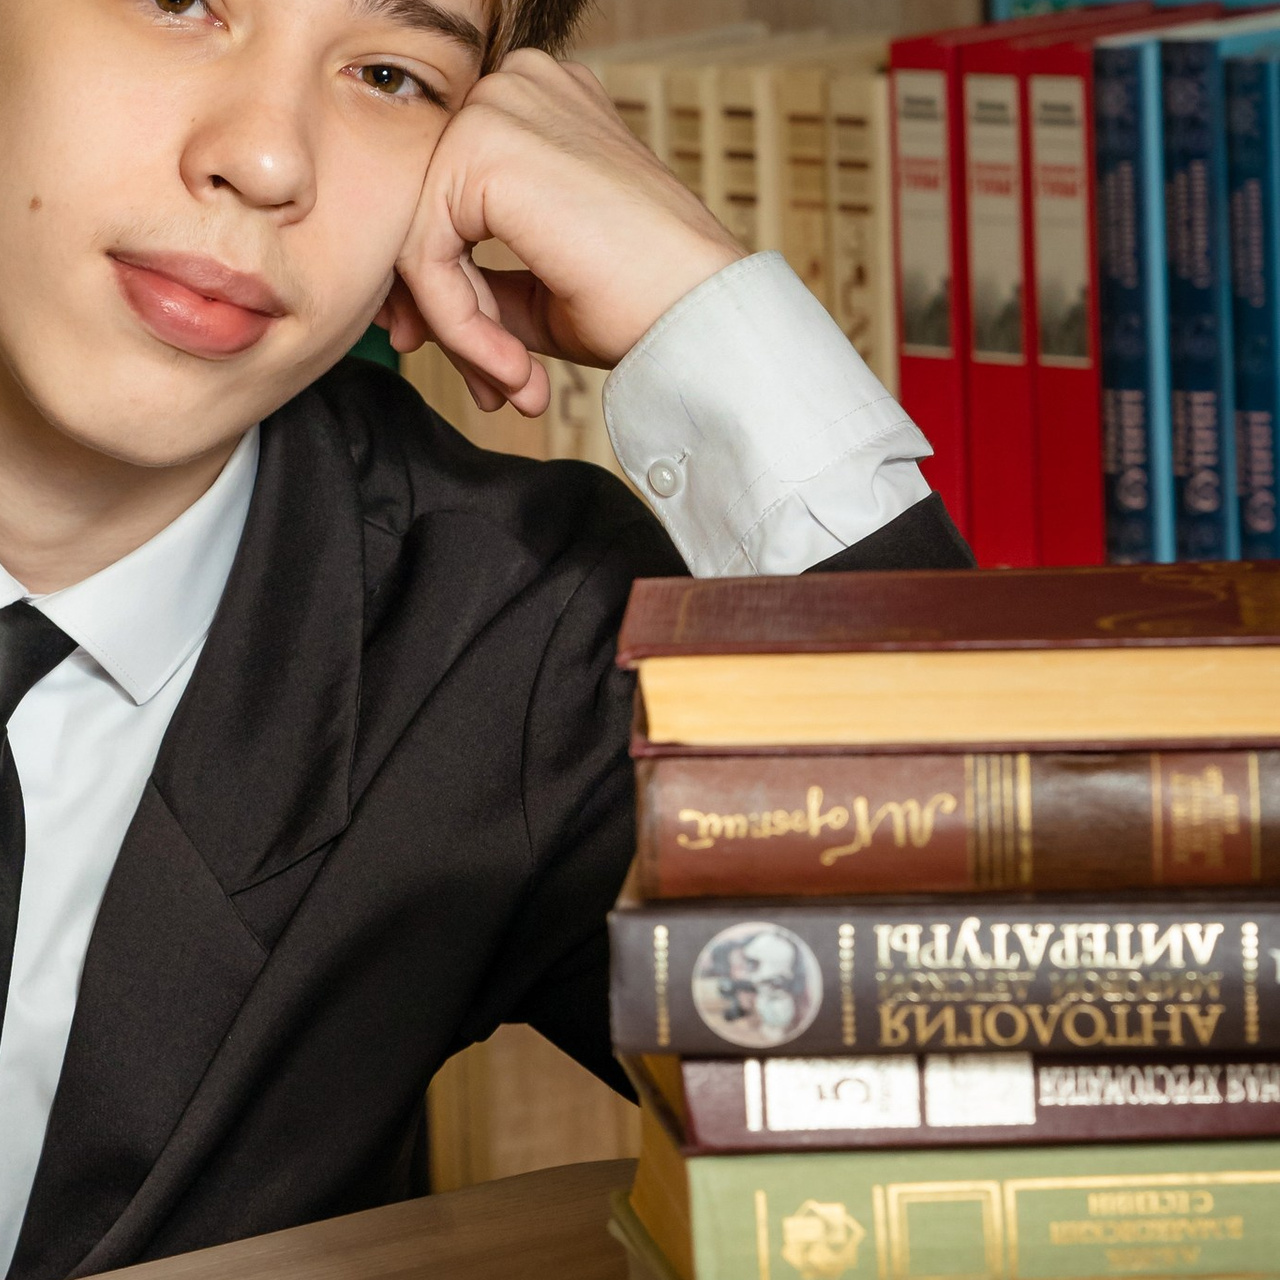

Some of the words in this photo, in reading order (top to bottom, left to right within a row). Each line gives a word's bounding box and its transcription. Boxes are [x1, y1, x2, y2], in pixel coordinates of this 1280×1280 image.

[873, 916, 1225, 970] ЛИТЕРАТУРЫ
[877, 1003, 1226, 1047] АНТОЛОГИЯ
[1037, 1064, 1223, 1107] ХРЕСТОМАТИЯ
